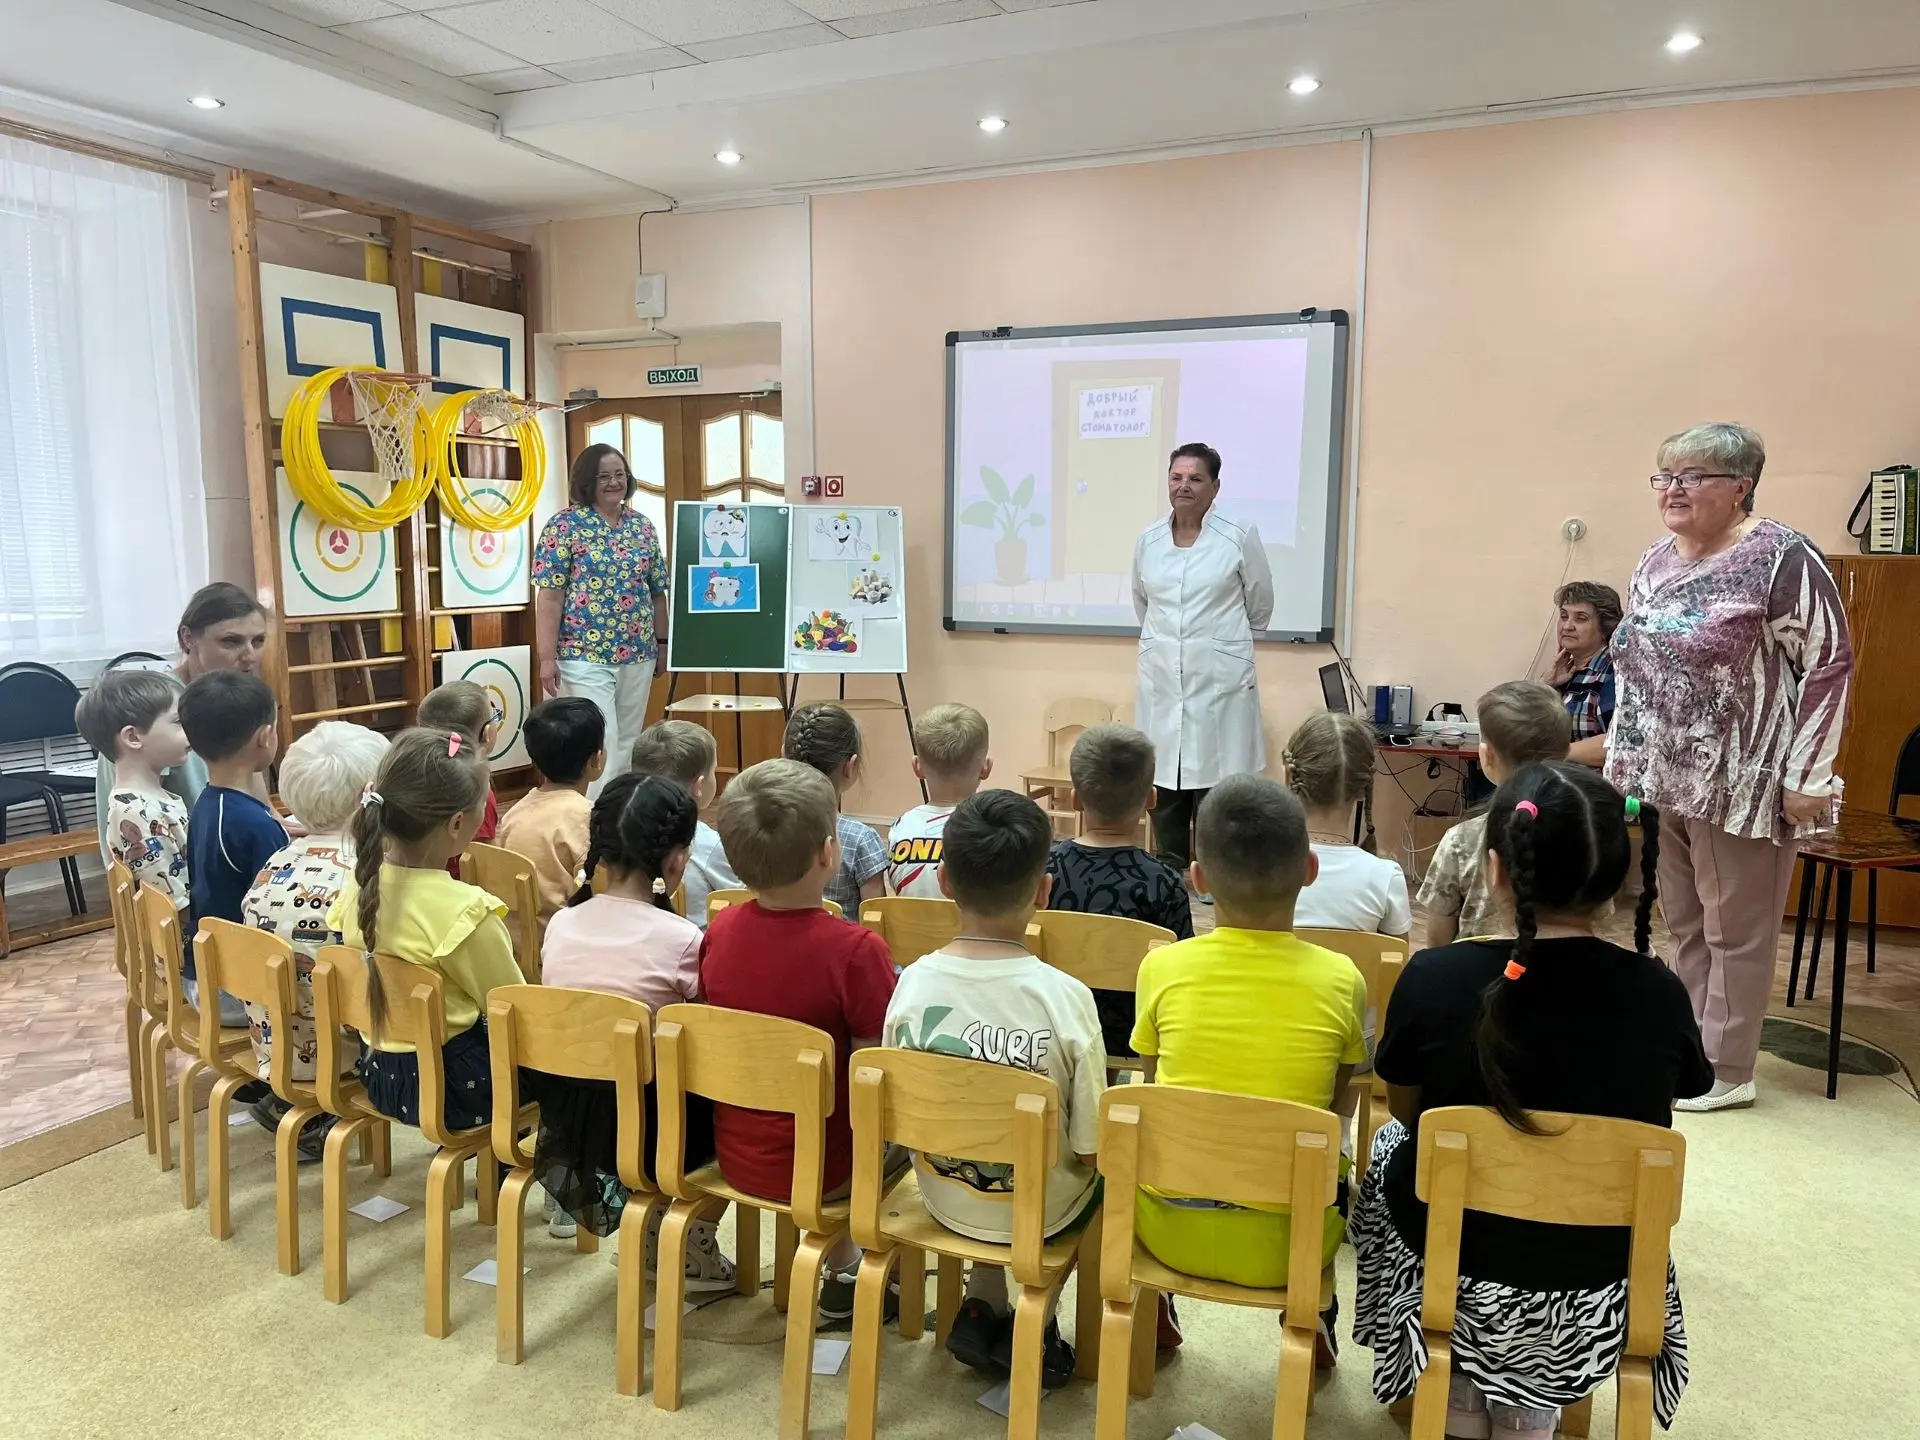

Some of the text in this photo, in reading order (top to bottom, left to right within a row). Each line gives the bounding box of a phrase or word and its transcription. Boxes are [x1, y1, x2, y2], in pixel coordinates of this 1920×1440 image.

[649, 369, 696, 383] ВЫХОД
[1087, 388, 1139, 407] ДОБРЫЙ
[1093, 407, 1137, 420] ДОКТОР
[1081, 422, 1146, 433] СТОМАТОЛОГ
[890, 837, 944, 865] ONI
[960, 1020, 1052, 1067] SURF
